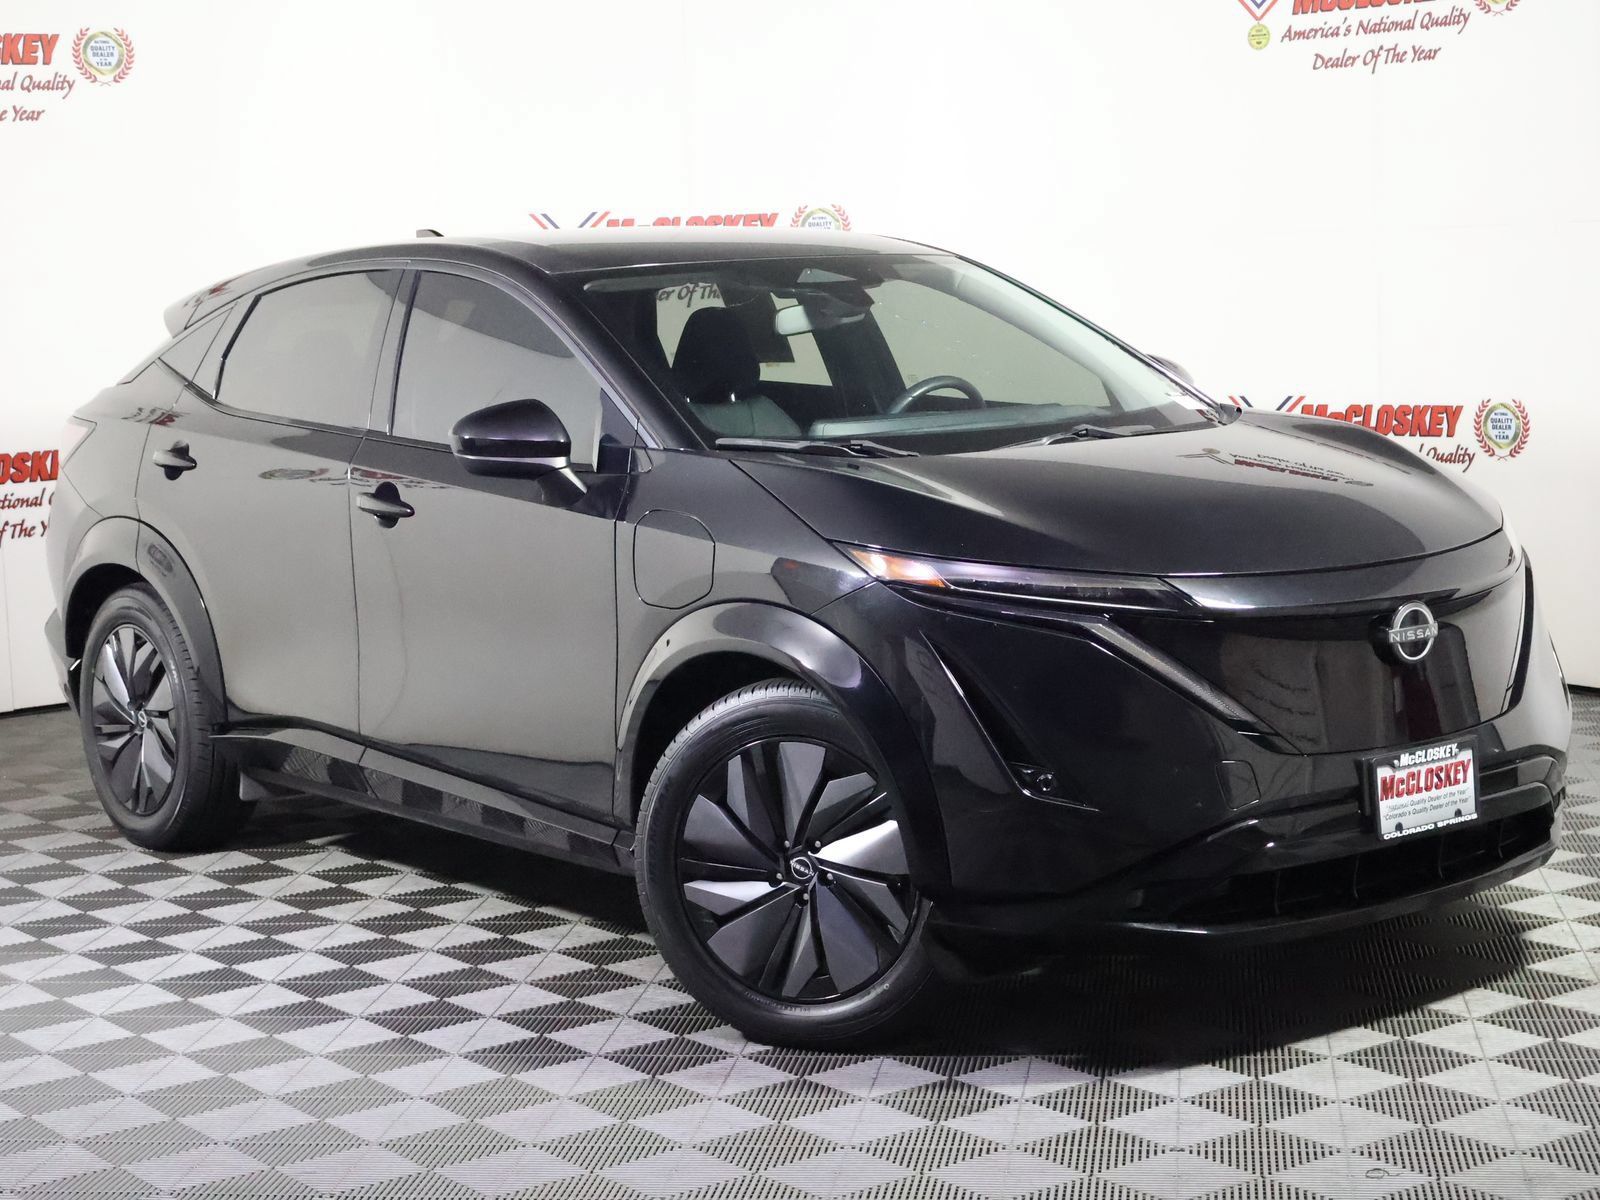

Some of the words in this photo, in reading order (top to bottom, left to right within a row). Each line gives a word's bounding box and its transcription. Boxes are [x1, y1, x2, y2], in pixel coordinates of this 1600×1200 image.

[1280, 17, 1352, 43] America's
[1355, 9, 1419, 36] National
[1420, 5, 1472, 35] Quality
[0, 33, 60, 65] KEY
[1312, 48, 1360, 70] Dealer
[1362, 45, 1384, 74] Of
[1384, 43, 1408, 65] The
[1411, 45, 1442, 63] Year
[20, 71, 76, 100] Quality
[12, 105, 46, 122] Year
[1301, 404, 1464, 438] CLOSKEY
[10, 519, 36, 539] The
[1389, 626, 1438, 643] NISSAN
[1400, 743, 1459, 767] McCLOSKEY
[1380, 758, 1471, 801] McCLOSKEY
[1384, 824, 1435, 839] COLORADO
[1436, 813, 1478, 828] SPRINGS
